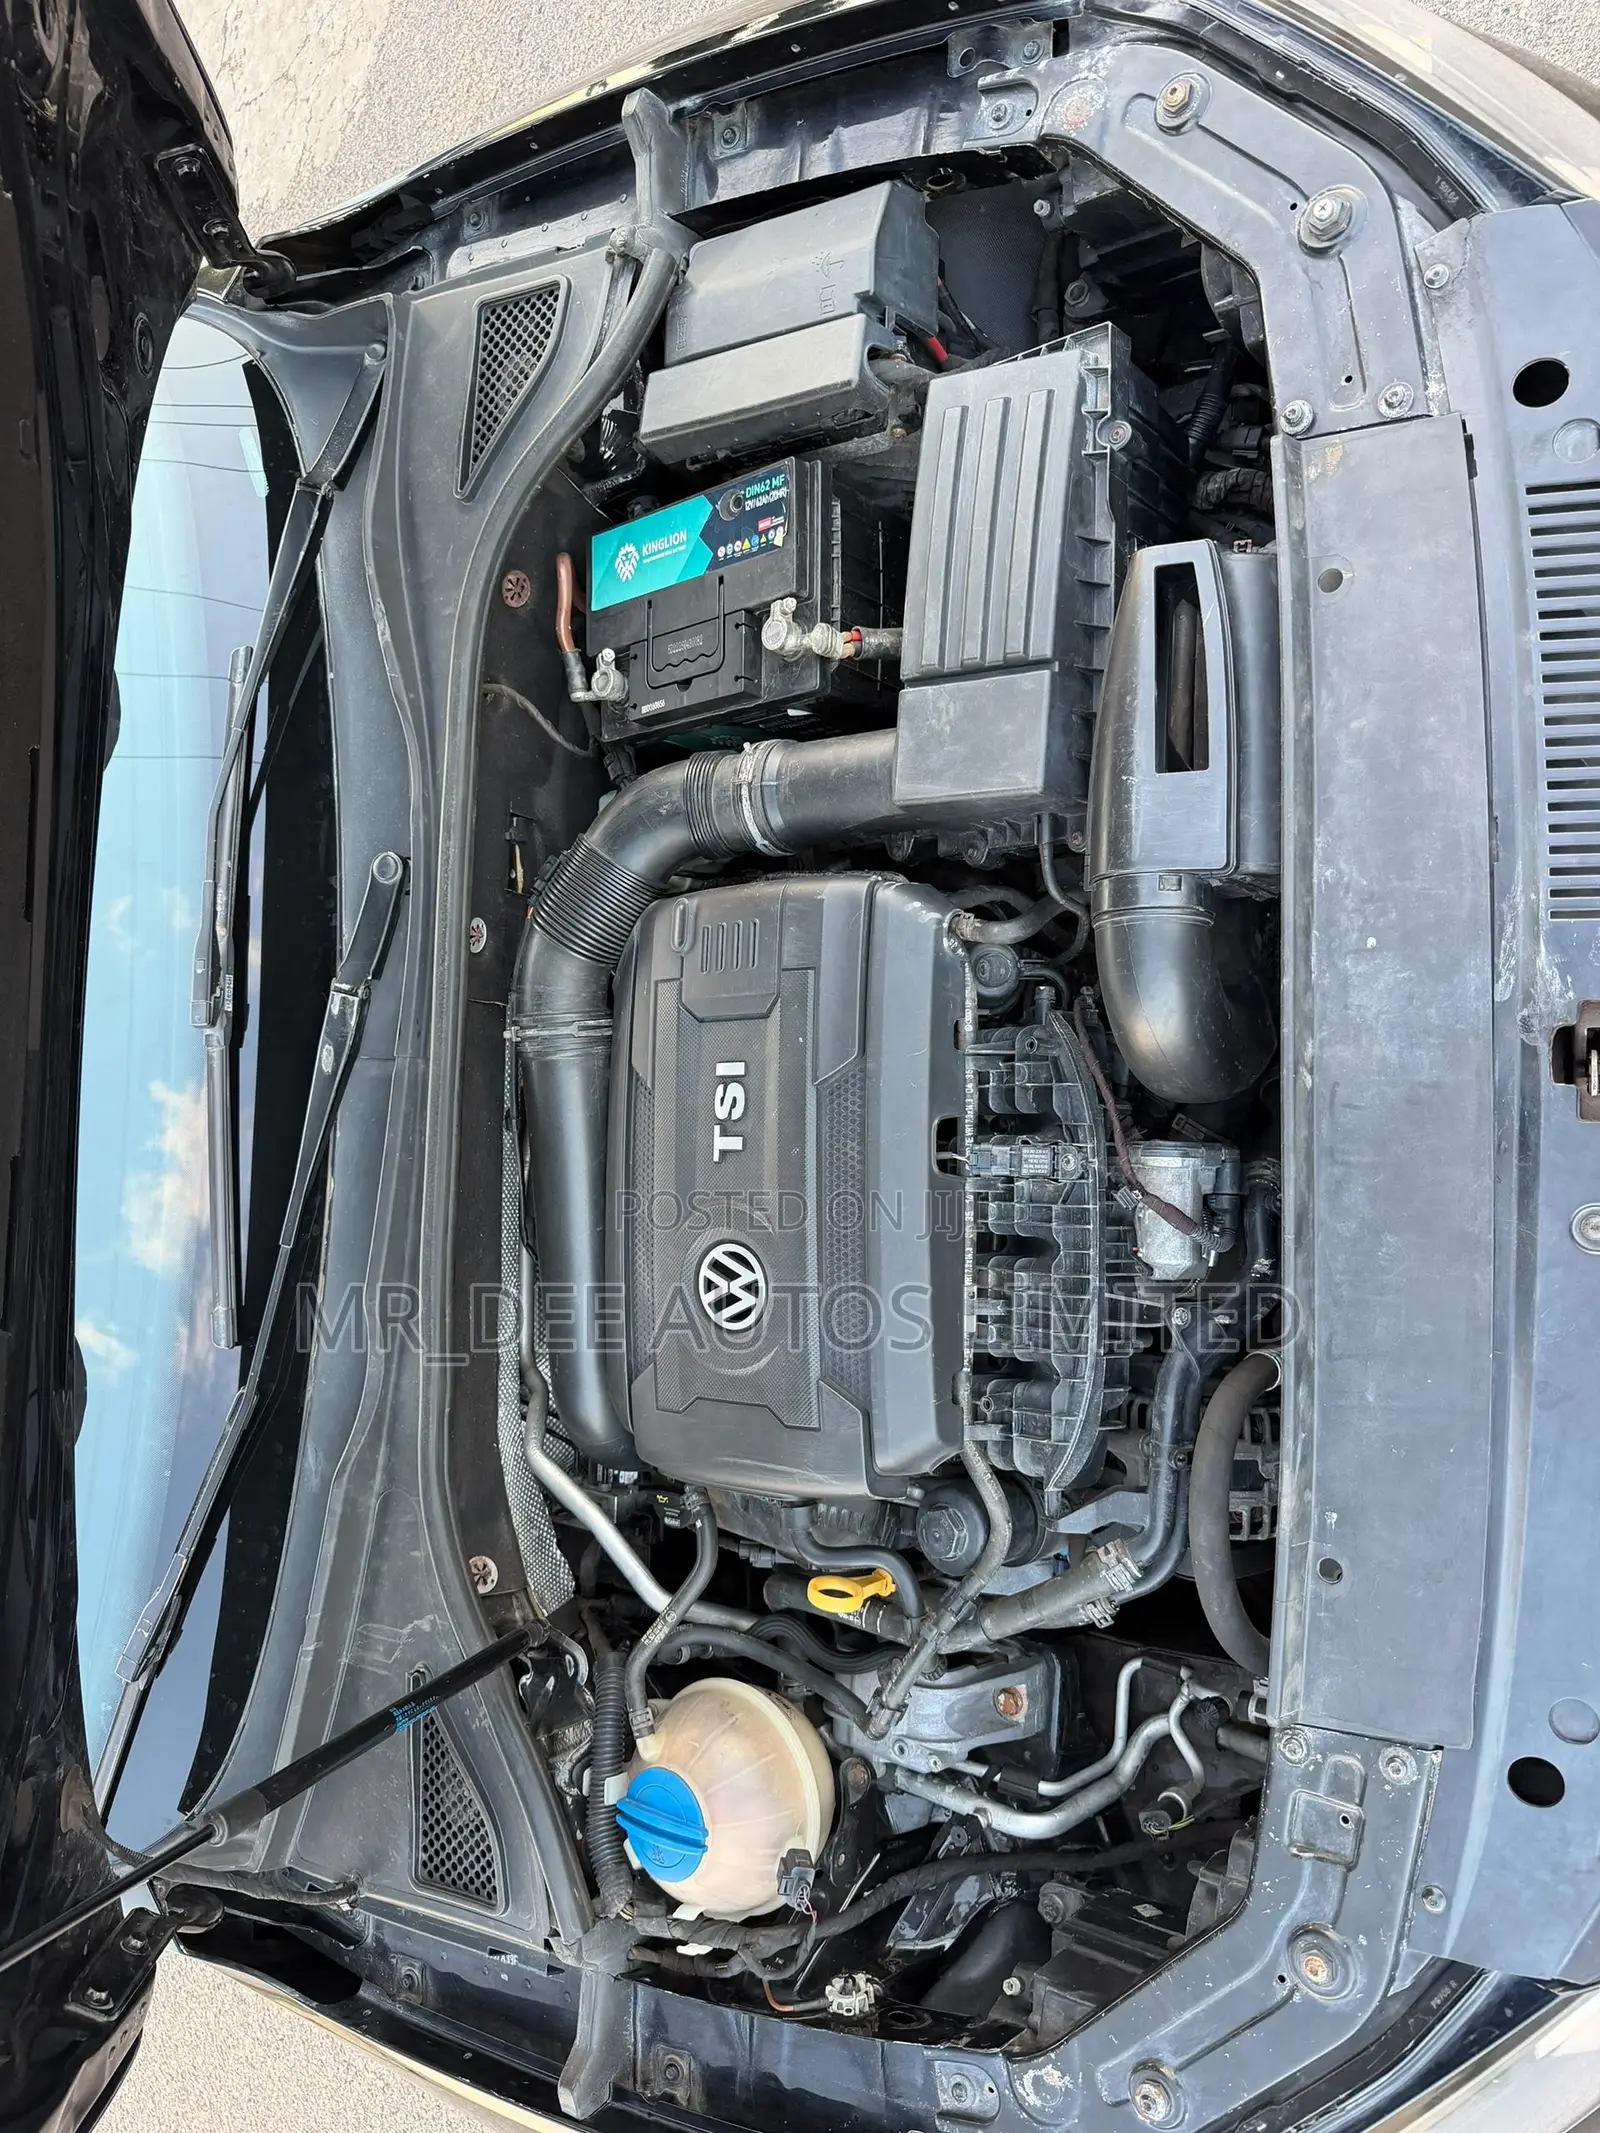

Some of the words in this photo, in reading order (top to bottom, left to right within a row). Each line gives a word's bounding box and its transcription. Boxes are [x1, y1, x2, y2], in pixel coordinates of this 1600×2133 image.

[746, 479, 771, 498] DIN62
[771, 474, 785, 488] MF
[642, 528, 687, 557] KINGLION
[713, 1061, 745, 1162] TSI
